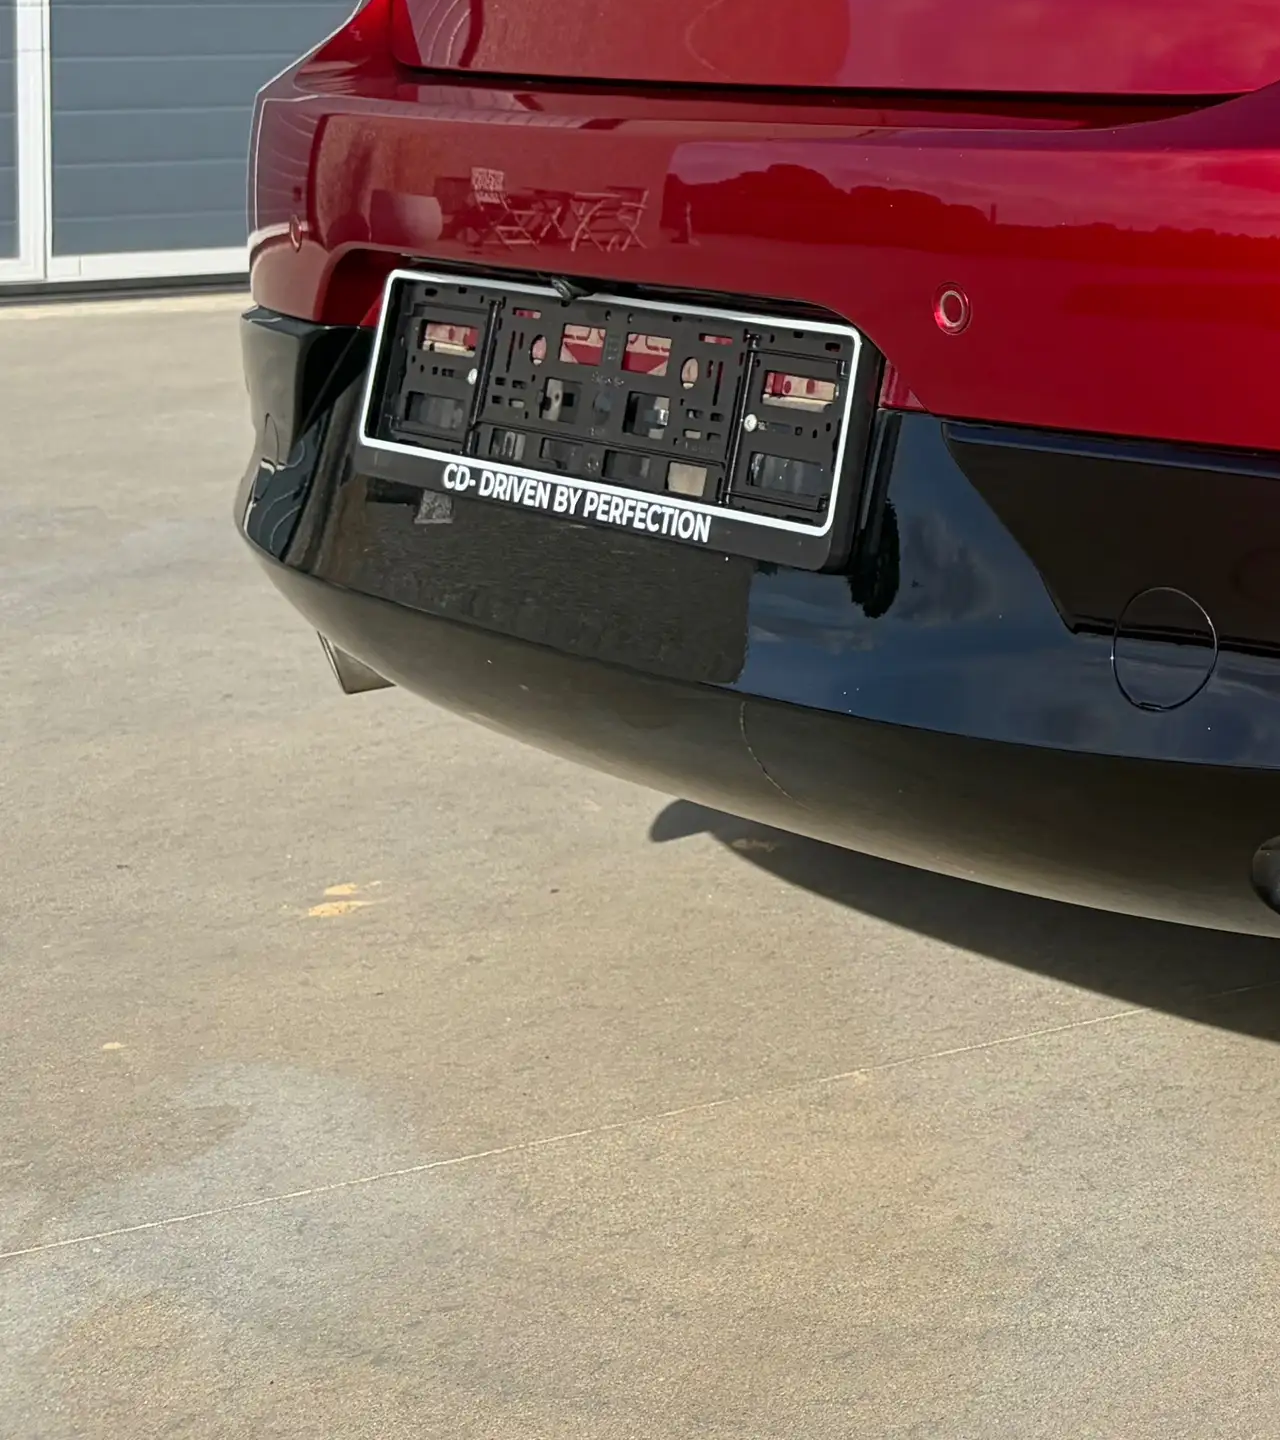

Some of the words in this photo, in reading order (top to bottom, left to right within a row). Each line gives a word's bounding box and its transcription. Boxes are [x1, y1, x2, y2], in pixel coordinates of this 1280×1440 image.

[478, 471, 551, 509] DRIVEN
[553, 487, 582, 515] BY
[583, 491, 712, 543] PERFECTION
